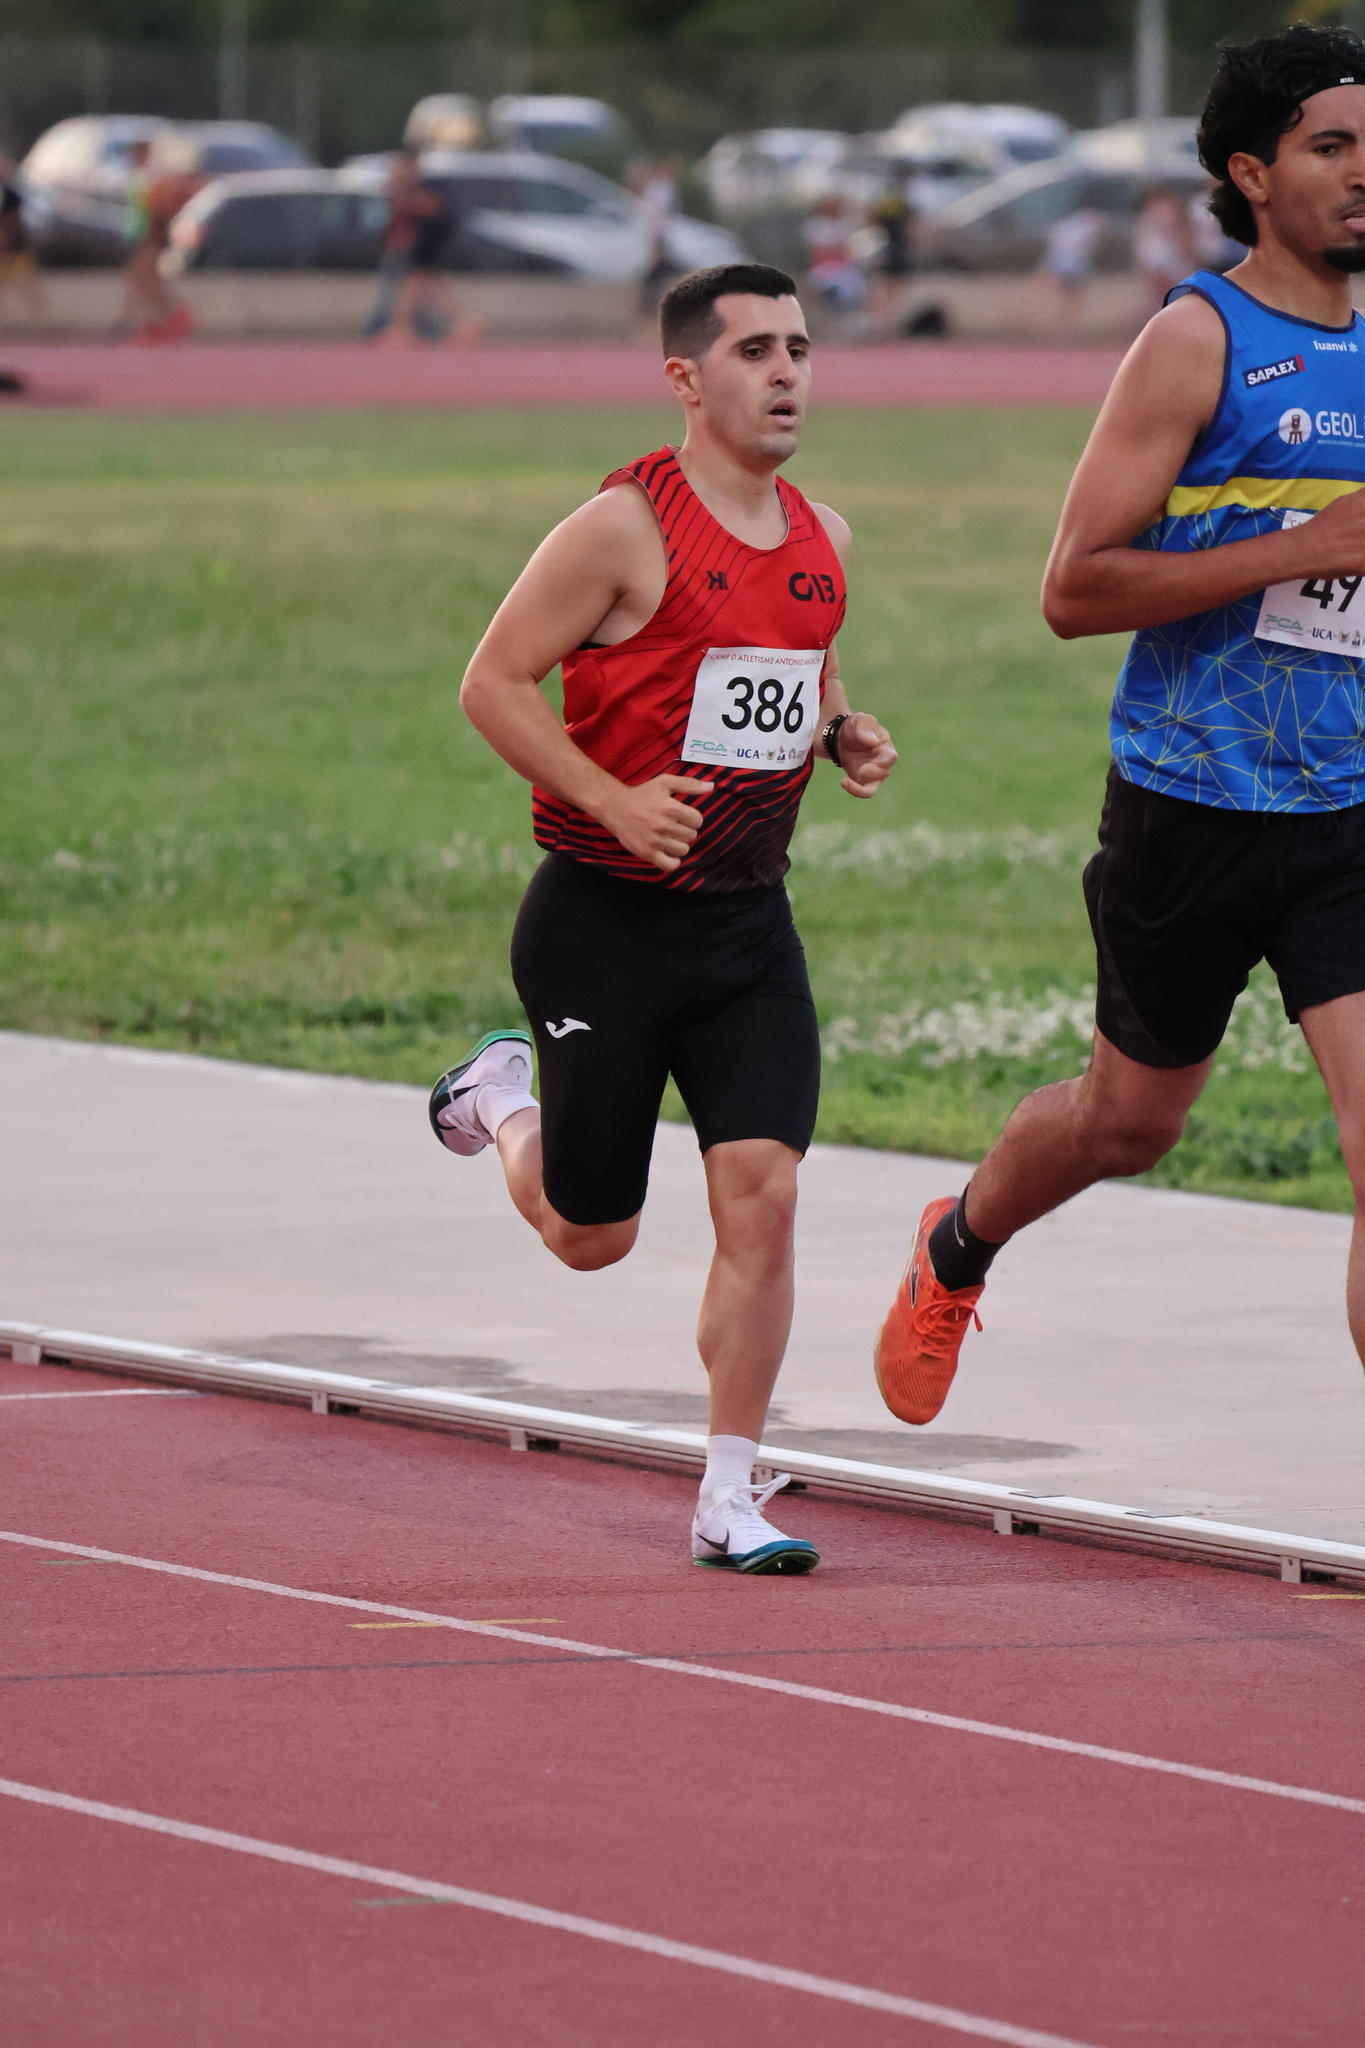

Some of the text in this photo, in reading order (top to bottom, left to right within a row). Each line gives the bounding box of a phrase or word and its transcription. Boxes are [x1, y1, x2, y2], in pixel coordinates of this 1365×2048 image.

[1247, 360, 1297, 385] SAPLEX
[1315, 410, 1365, 439] GEOL
[1312, 627, 1333, 641] UCA
[721, 676, 804, 734] 386
[736, 747, 760, 759] UCA
